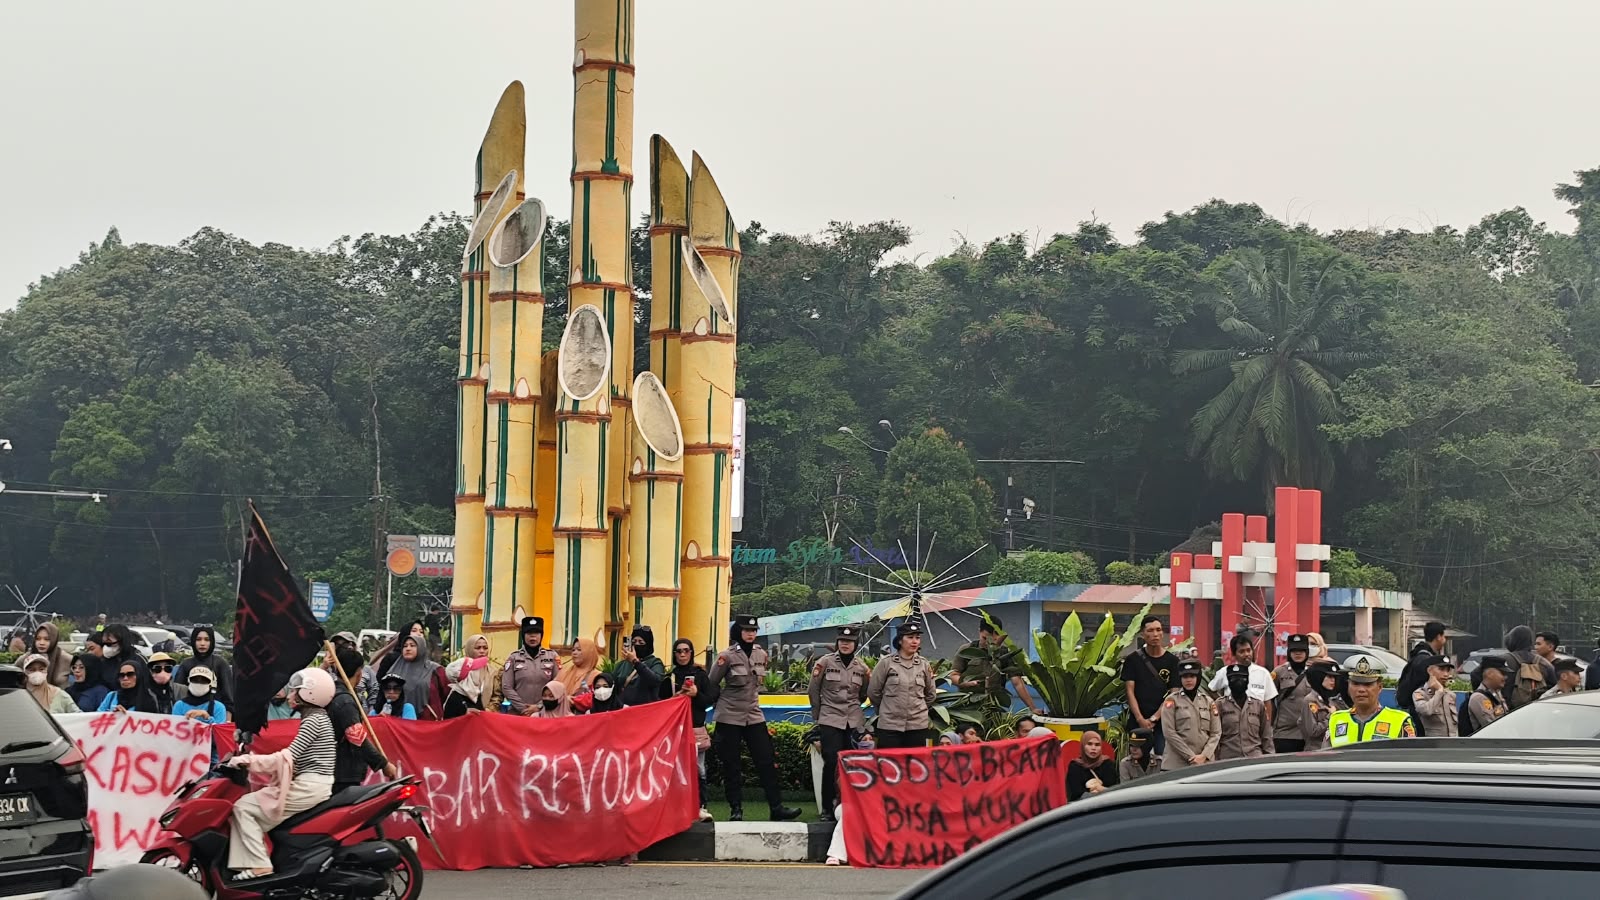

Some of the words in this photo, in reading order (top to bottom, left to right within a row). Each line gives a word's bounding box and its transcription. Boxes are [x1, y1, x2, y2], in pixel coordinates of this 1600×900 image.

[420, 536, 456, 548] RUMA
[420, 551, 455, 563] UNTA
[519, 724, 688, 820] REVOLUSI
[883, 796, 948, 836] BISA
